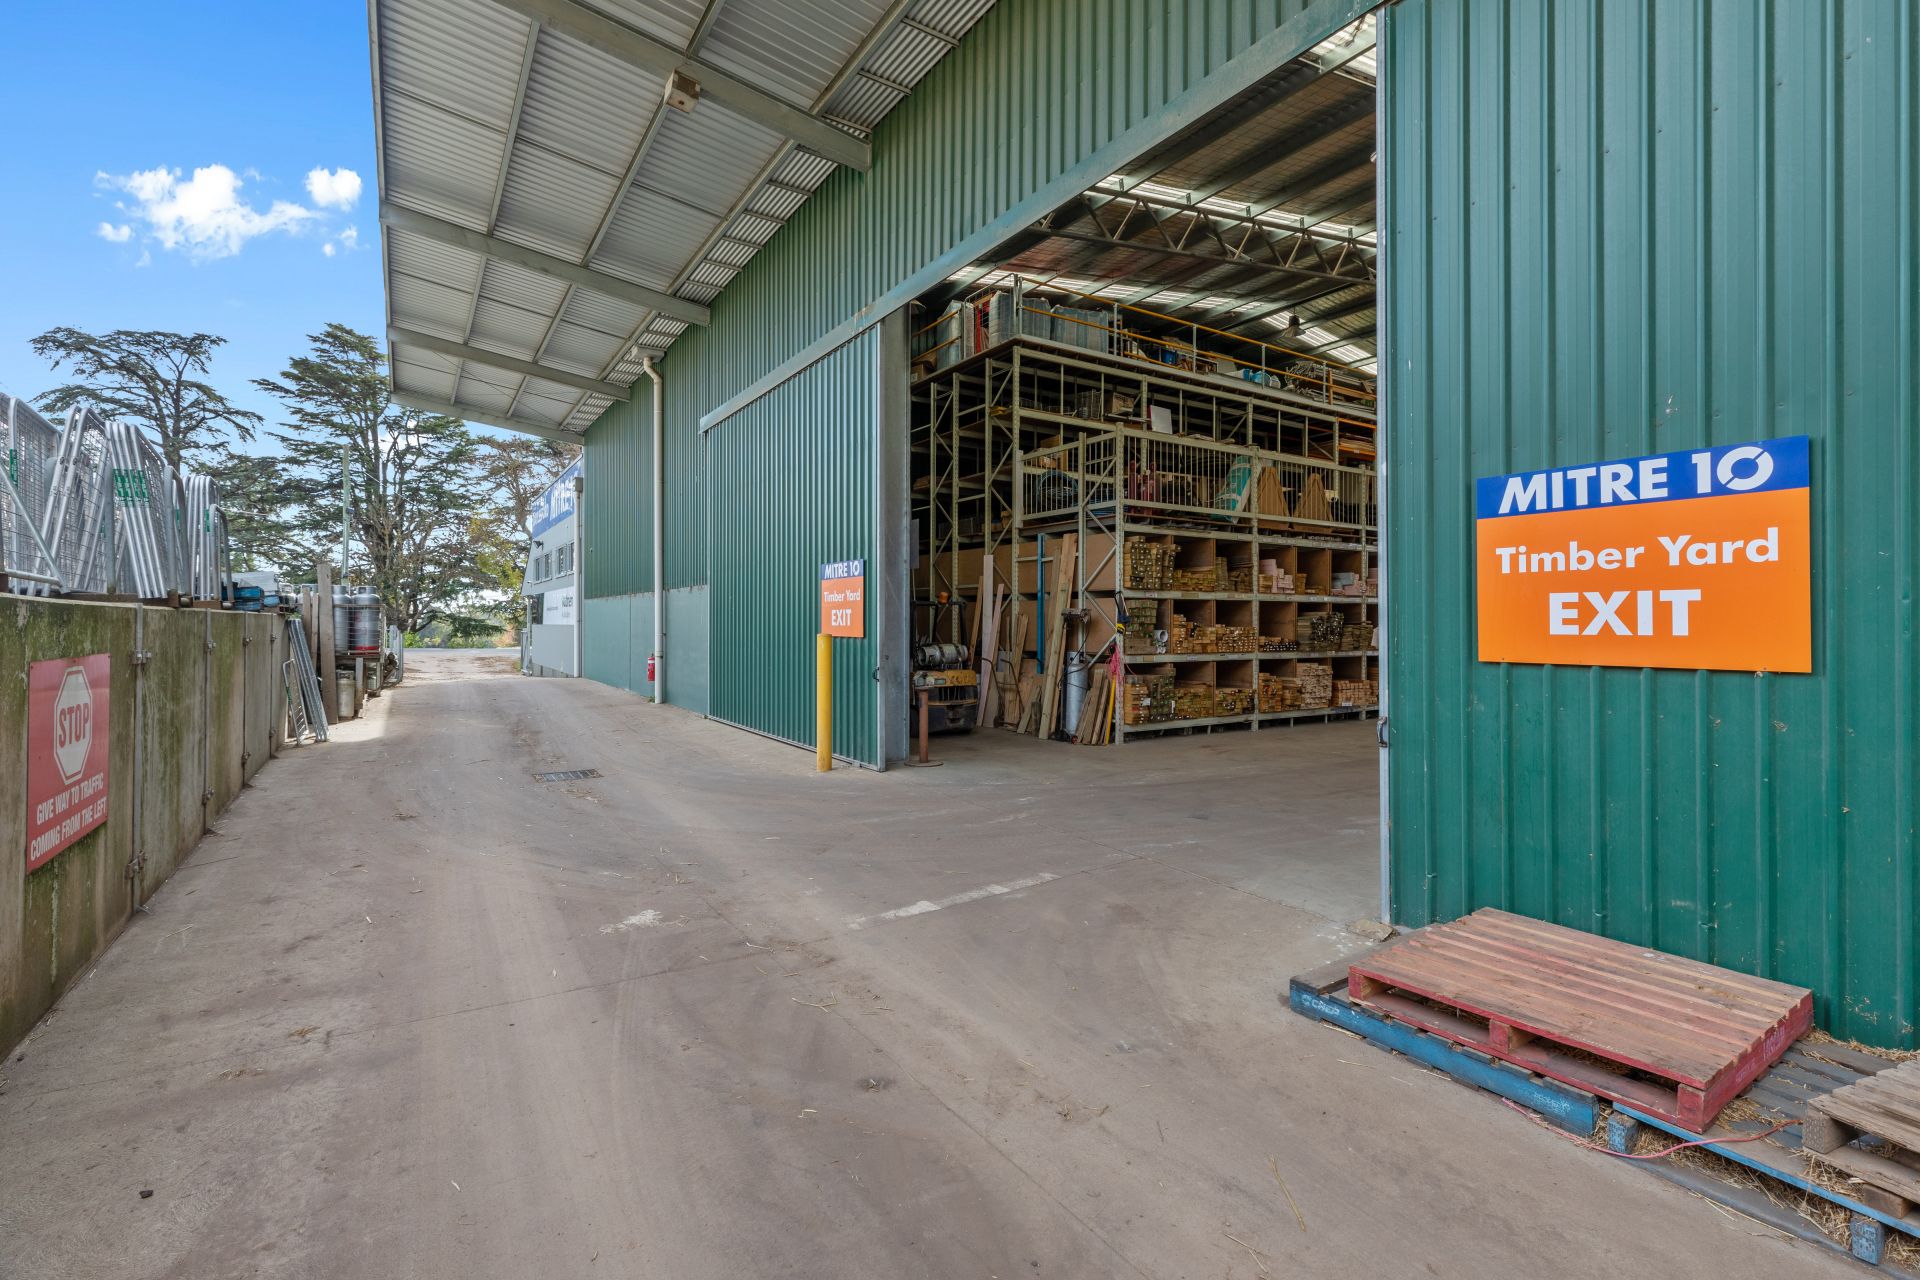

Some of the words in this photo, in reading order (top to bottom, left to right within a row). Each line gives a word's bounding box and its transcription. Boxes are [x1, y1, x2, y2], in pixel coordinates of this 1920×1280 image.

[1498, 457, 1669, 514] MITRE
[1691, 446, 1775, 494] 10
[824, 563, 848, 579] MITRE
[849, 561, 860, 576] 10
[1495, 541, 1645, 574] Timber
[1657, 526, 1779, 566] Yard
[824, 591, 845, 602] Timber
[845, 588, 861, 601] Yard
[831, 608, 852, 626] EXIT
[1549, 589, 1702, 637] EXIT
[58, 702, 90, 748] STOP
[36, 798, 54, 826] GIVE
[55, 790, 71, 815] WAY
[71, 784, 80, 806] TO
[80, 772, 104, 798] TRAFFIC
[31, 825, 61, 861] COMING
[61, 813, 81, 841] FROM
[81, 806, 93, 826] THE
[94, 797, 107, 819] LEFT
